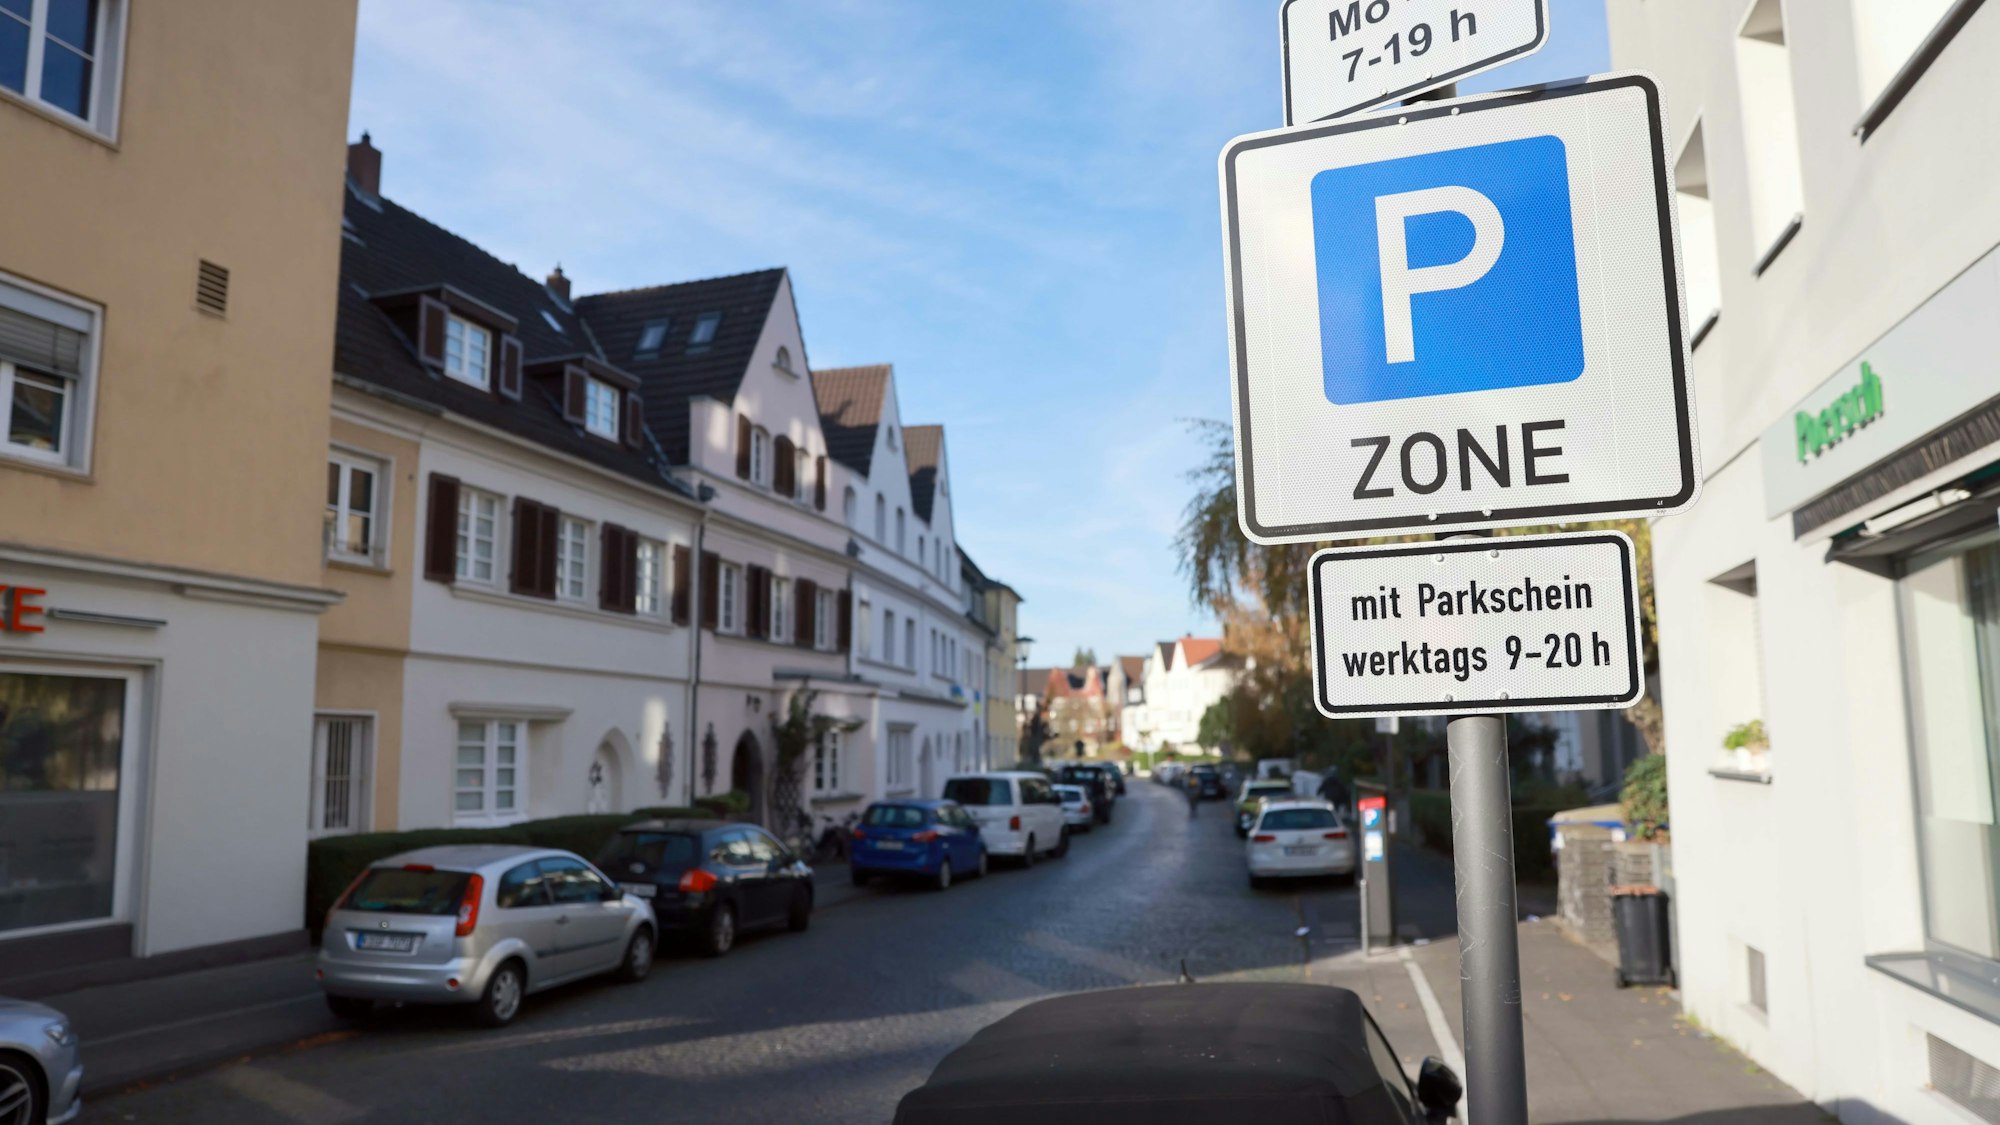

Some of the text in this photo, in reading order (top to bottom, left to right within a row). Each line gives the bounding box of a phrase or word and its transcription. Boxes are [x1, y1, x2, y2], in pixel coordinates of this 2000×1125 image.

[1342, 9, 1478, 83] 7-19 h
[1374, 185, 1505, 364] P
[1350, 419, 1570, 500] ZONE
[1351, 576, 1593, 621] mit Parkschein
[1341, 631, 1611, 682] werktags 9-20 h
